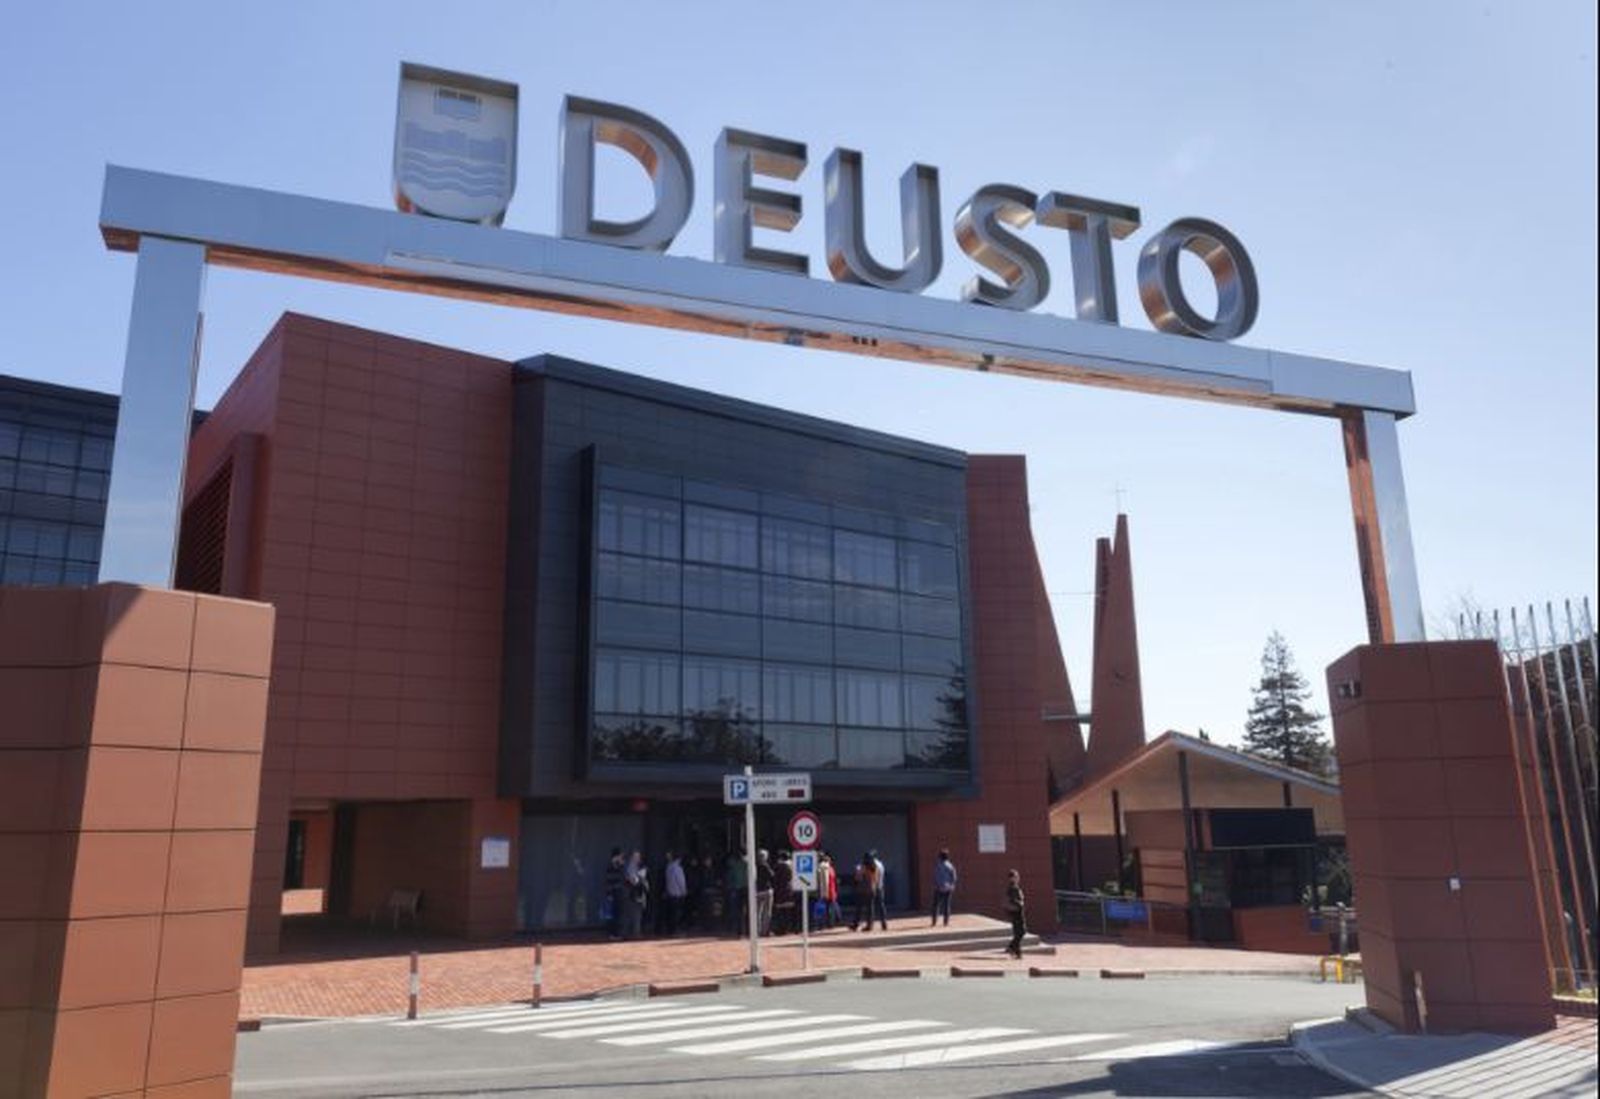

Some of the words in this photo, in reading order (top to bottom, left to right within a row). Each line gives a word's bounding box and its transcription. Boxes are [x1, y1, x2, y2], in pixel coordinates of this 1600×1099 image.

[558, 93, 1260, 342] DEUSTO
[733, 782, 746, 798] P
[797, 824, 813, 838] 10
